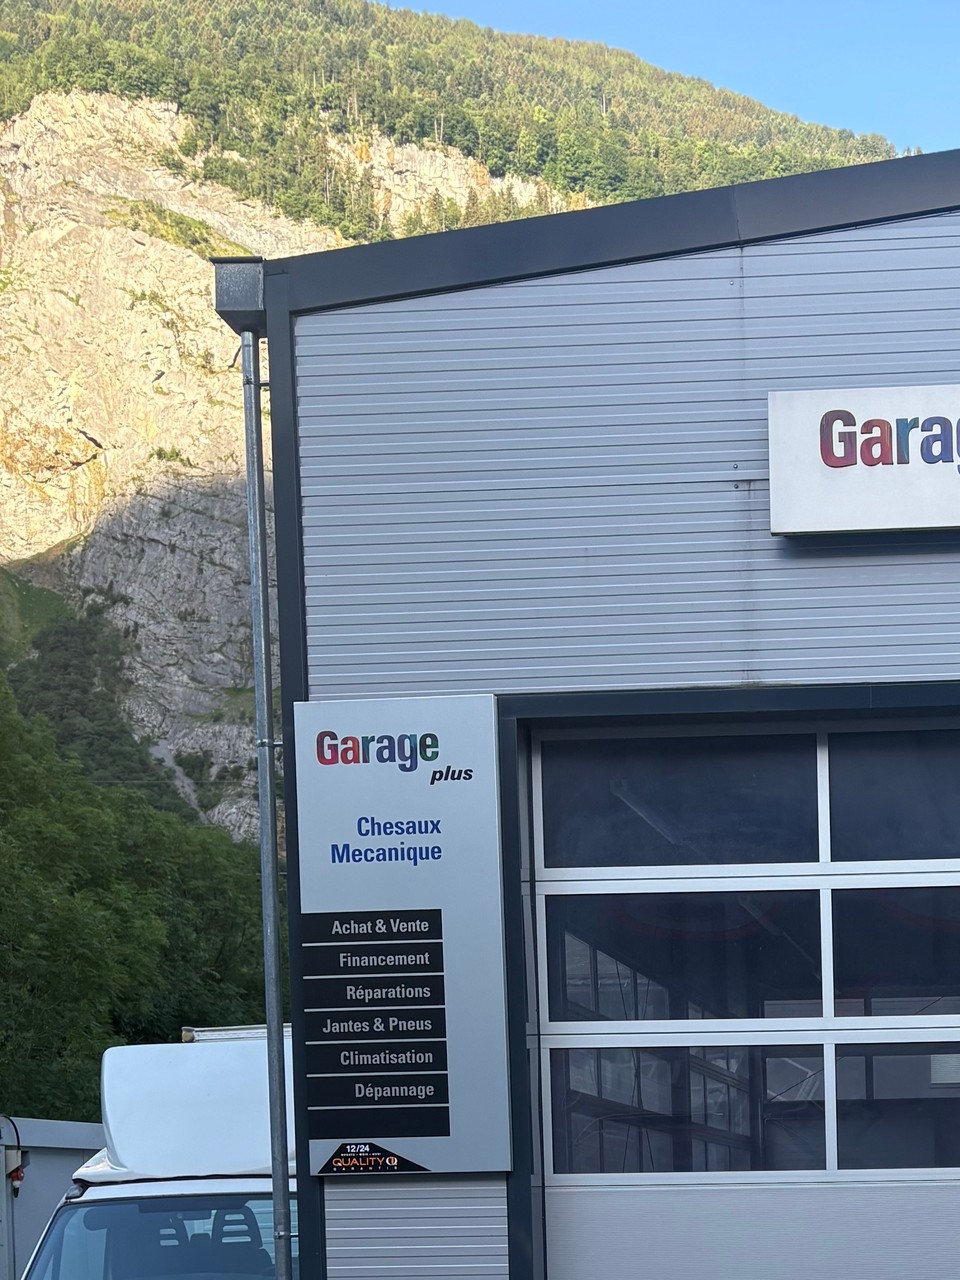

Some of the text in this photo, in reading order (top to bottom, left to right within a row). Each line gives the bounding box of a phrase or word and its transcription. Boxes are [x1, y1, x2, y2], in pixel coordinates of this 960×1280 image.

[316, 730, 440, 773] Garage
[429, 765, 474, 786] plus
[356, 816, 442, 837] Chesaux
[330, 841, 443, 867] Mecanique
[331, 918, 430, 935] Achat & Vente
[338, 951, 430, 968] Financement
[346, 983, 431, 1003] Réparations
[322, 1016, 433, 1034] Jantes & Pneus
[340, 1049, 434, 1066] Climatisation
[354, 1082, 435, 1101] Dépannage
[346, 1144, 370, 1153] 12/24
[332, 1156, 385, 1167] QUALITY
